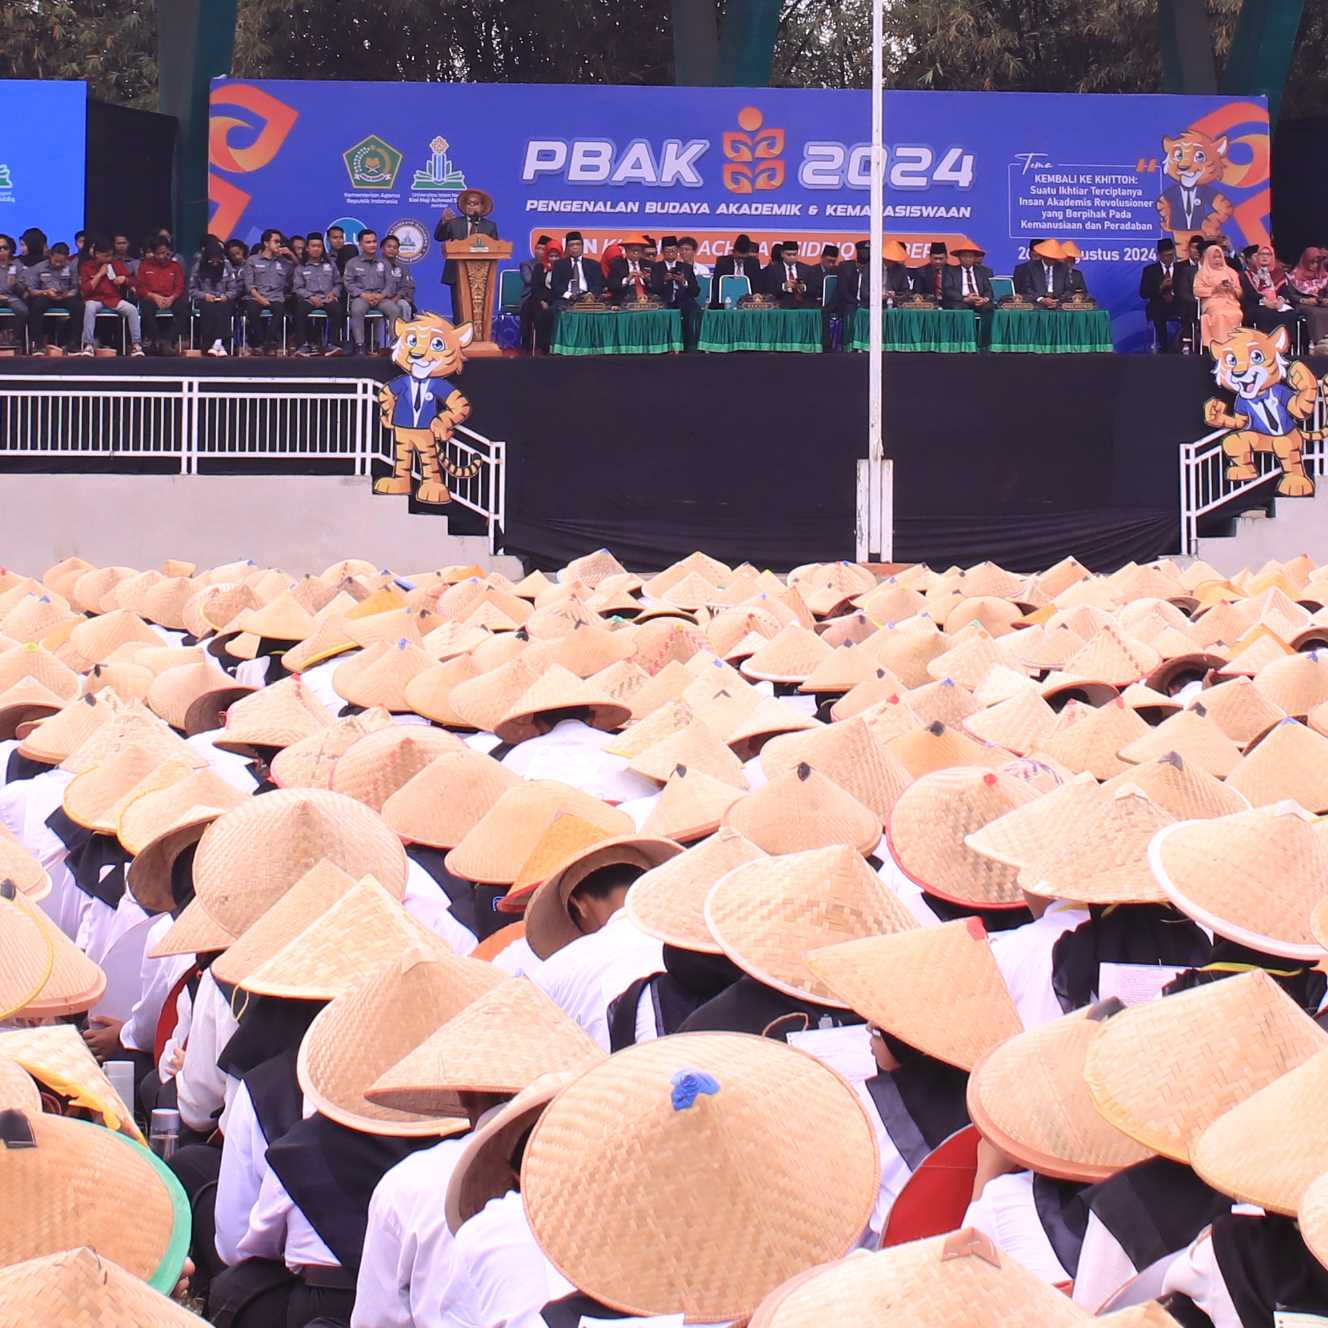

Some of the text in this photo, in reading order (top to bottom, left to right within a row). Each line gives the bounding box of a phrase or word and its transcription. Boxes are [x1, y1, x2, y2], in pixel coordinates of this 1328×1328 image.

[522, 139, 706, 184] PBAK
[801, 145, 975, 188] 2024
[1034, 175, 1139, 185] KEMBALI KE KHITTOH:
[1030, 186, 1143, 197] Suatu Ikhtiar Terciptanya
[1019, 197, 1154, 208] Insan Akademis Revolusioner
[525, 199, 972, 218] PENGENALAN BUDAYA AKADEMIK & KEMAASISWAAN
[1041, 209, 1132, 220] yang Berpihak Pada
[1020, 220, 1153, 231] Kemanusiaan dan Peradaban
[1124, 247, 1157, 261] 2024
